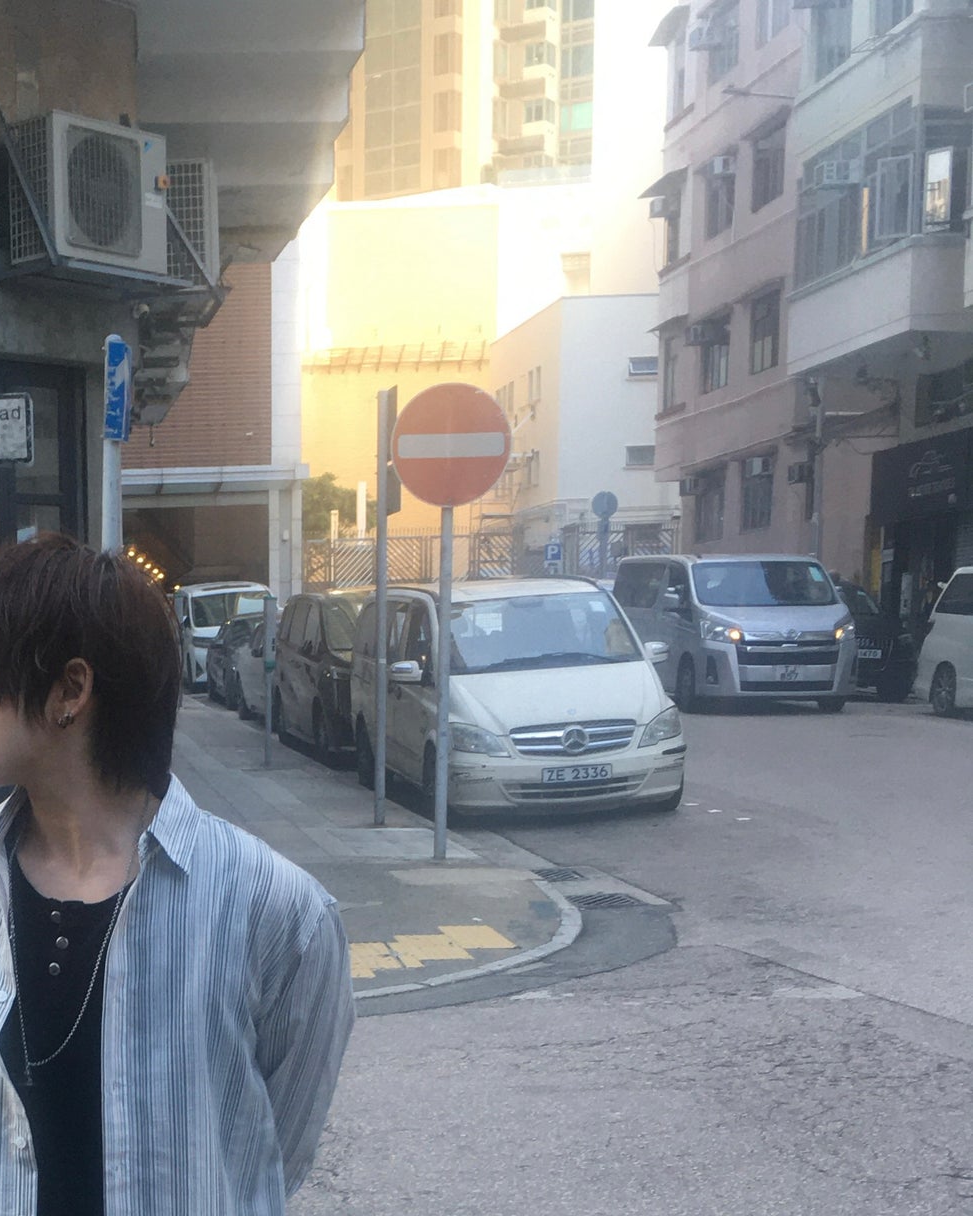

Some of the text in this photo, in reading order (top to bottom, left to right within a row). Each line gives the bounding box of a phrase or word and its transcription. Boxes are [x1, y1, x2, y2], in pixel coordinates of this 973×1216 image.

[547, 545, 559, 560] P
[547, 766, 608, 781] ZE 2336
